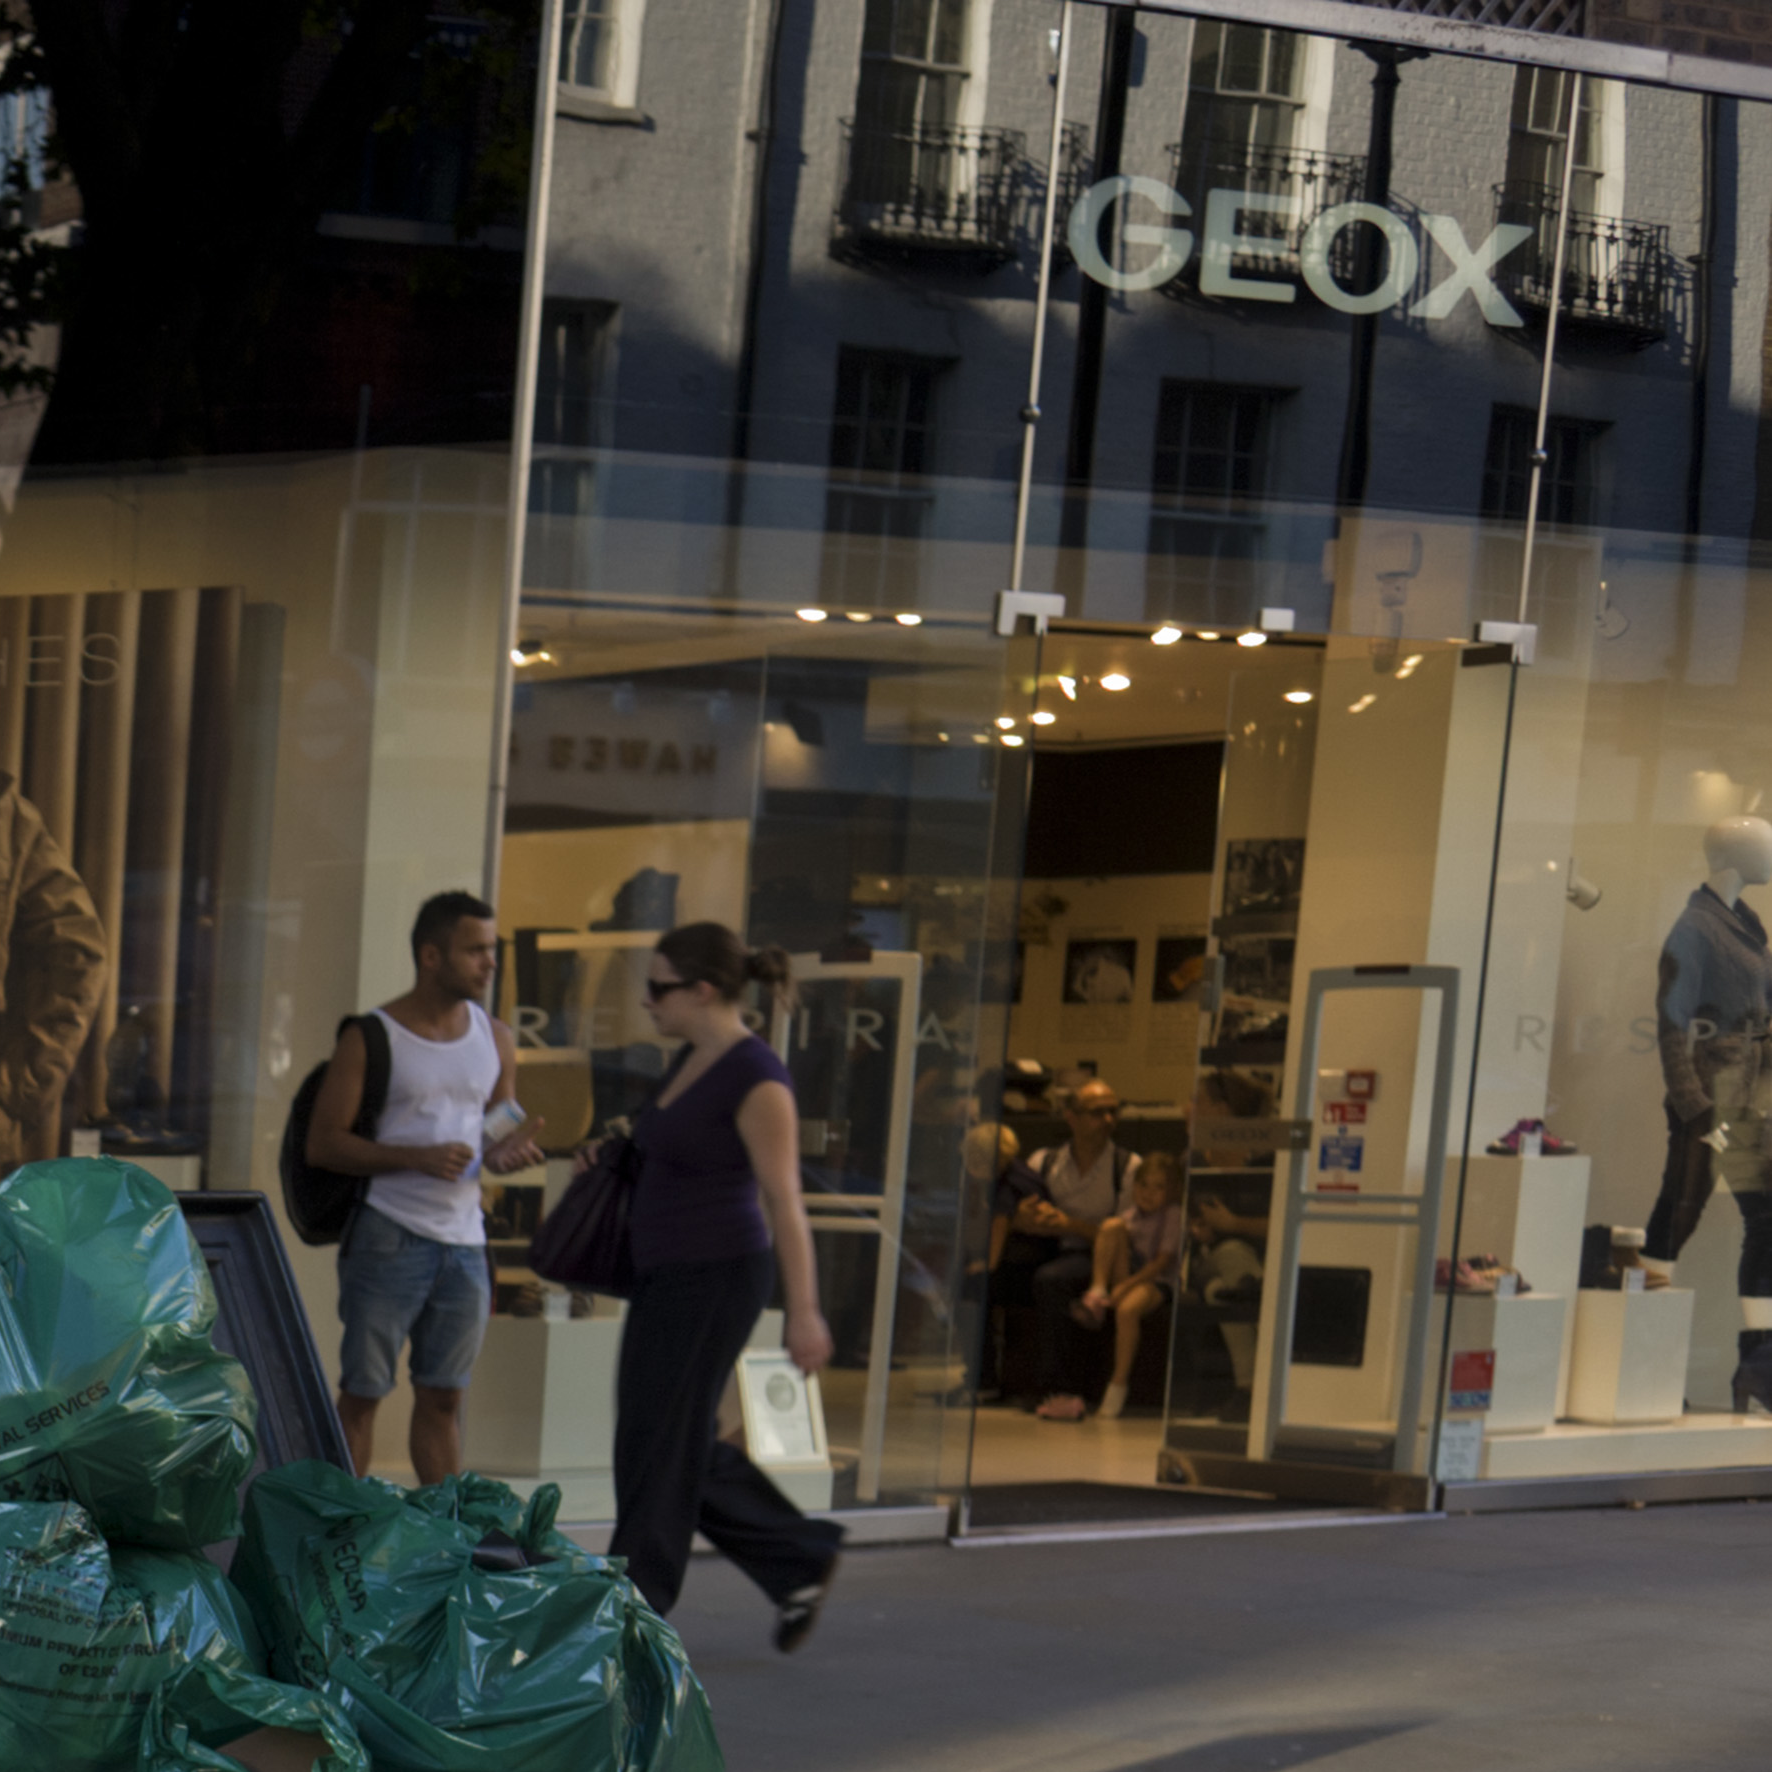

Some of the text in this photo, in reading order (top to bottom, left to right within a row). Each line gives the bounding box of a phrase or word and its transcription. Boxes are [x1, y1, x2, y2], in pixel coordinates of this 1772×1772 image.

[1068, 175, 1533, 328] GEOX
[511, 1005, 953, 1053] REPIRA
[24, 1380, 112, 1435] SERVICES
